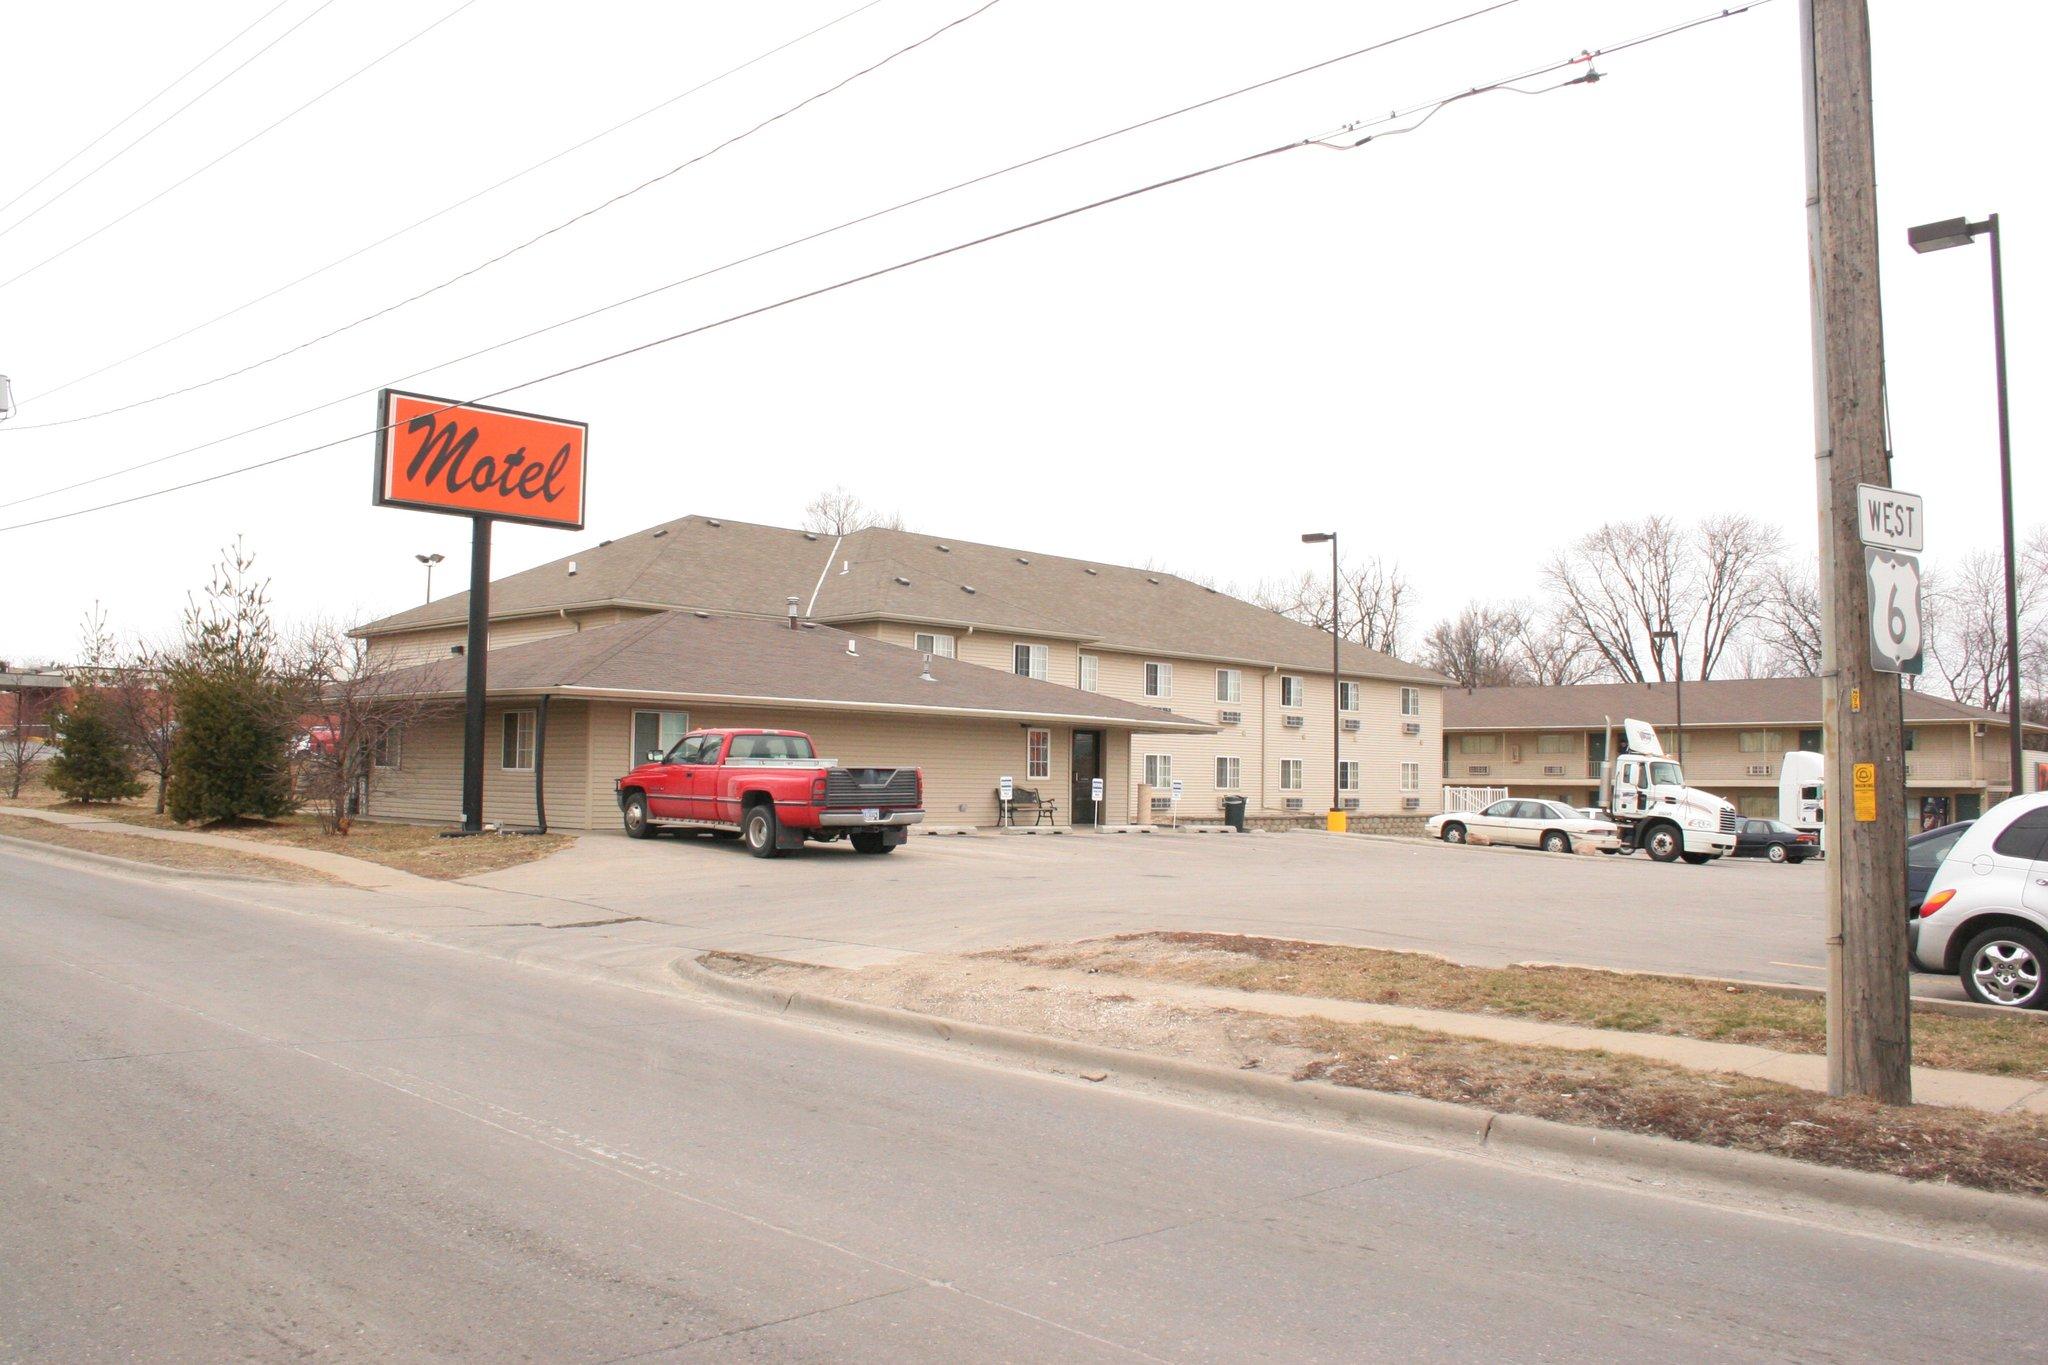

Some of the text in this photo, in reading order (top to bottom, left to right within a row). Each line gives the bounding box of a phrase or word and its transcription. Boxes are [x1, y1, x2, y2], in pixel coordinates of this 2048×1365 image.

[406, 413, 571, 503] Motel
[1868, 499, 1914, 538] WEST
[1887, 581, 1907, 645] 6
